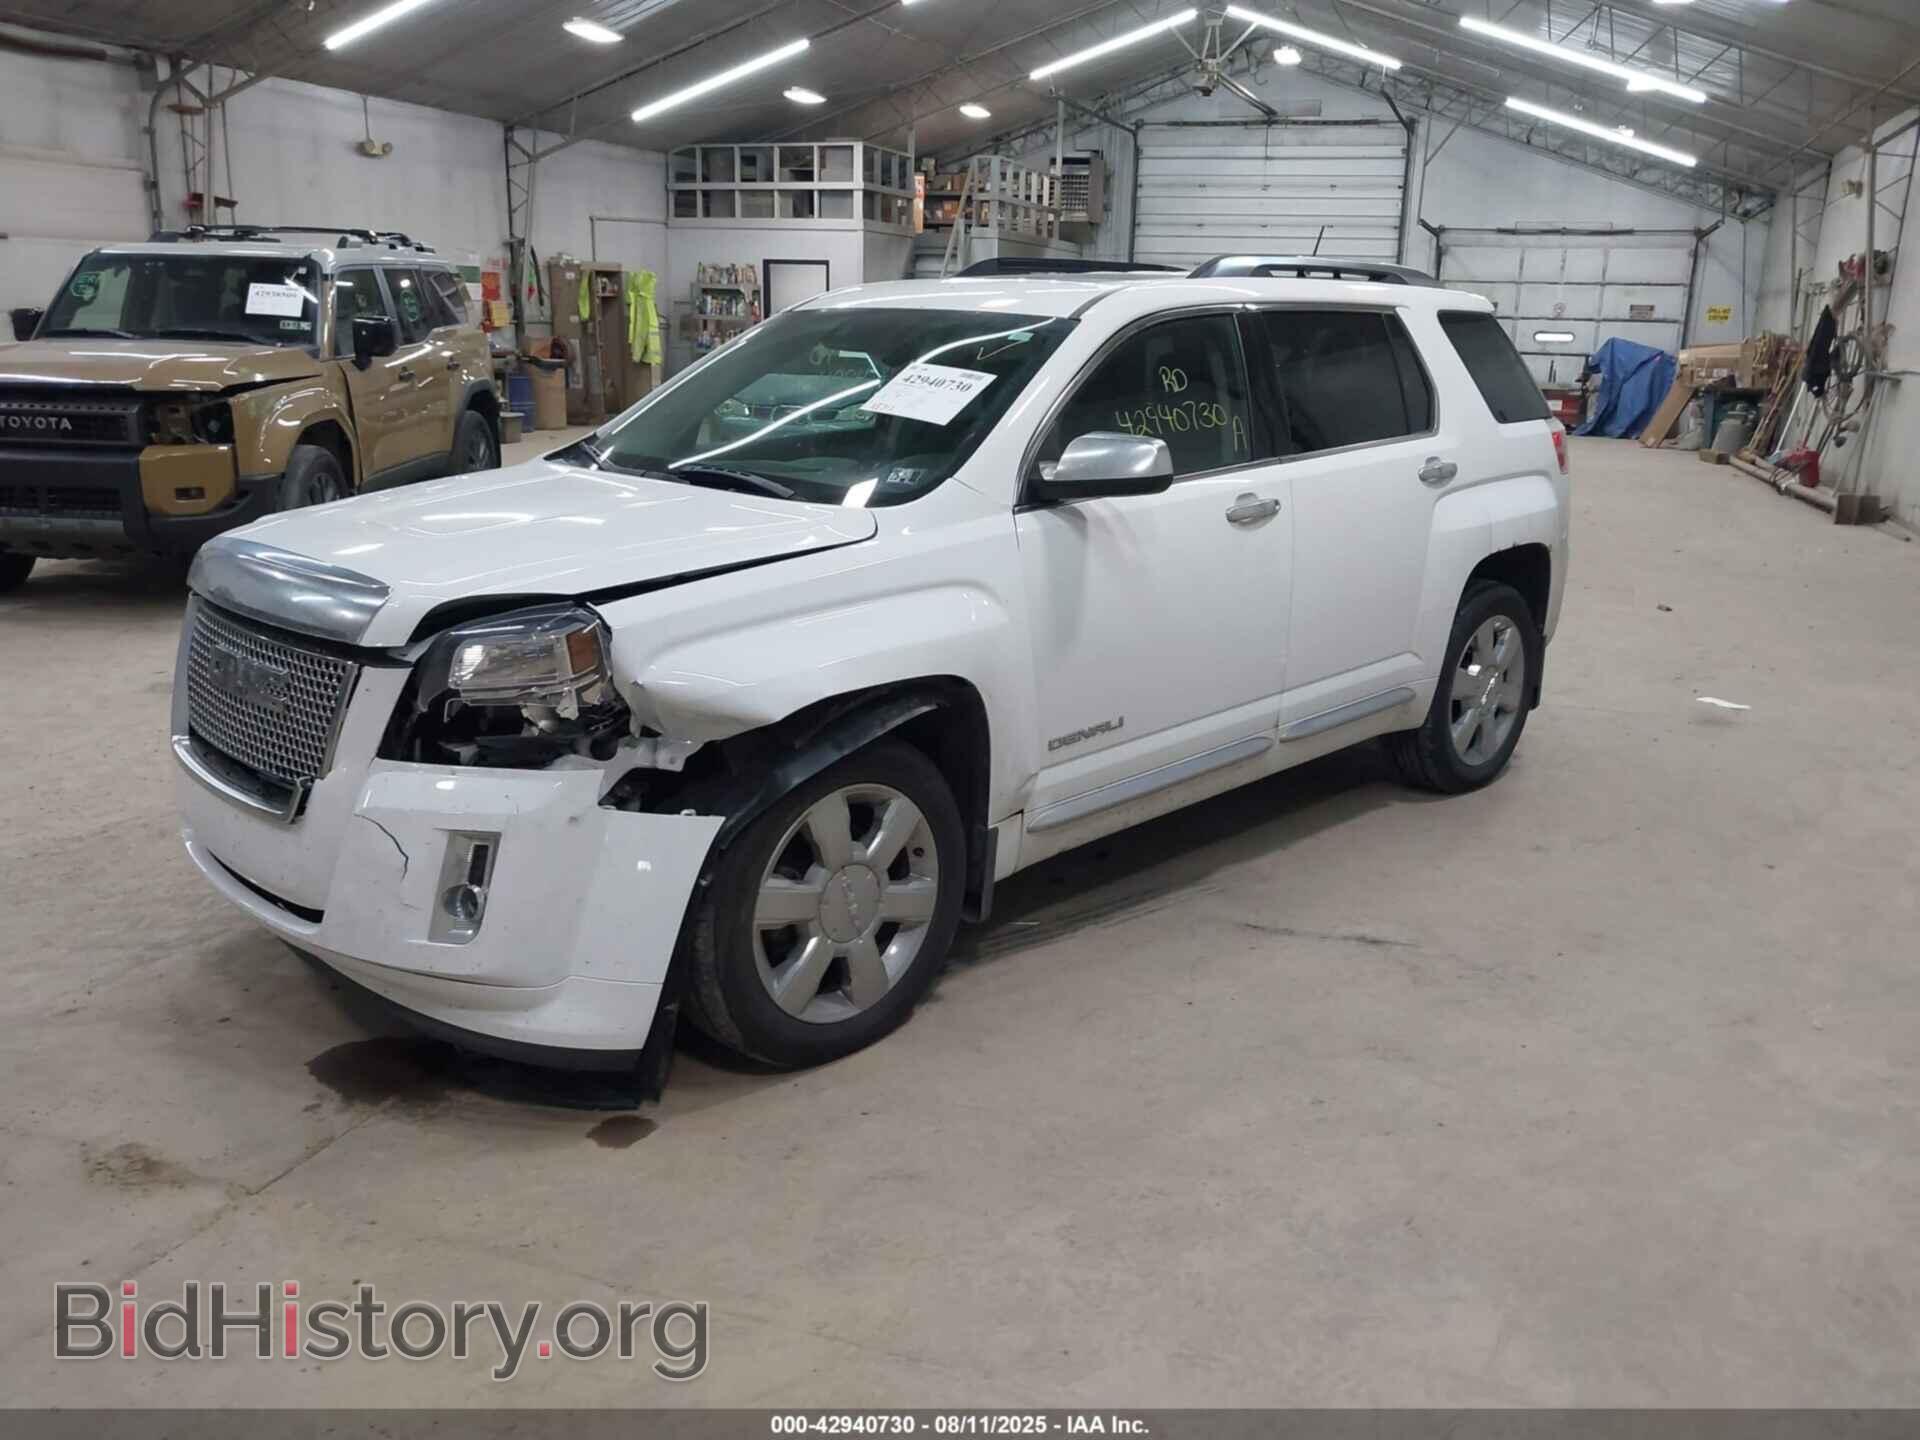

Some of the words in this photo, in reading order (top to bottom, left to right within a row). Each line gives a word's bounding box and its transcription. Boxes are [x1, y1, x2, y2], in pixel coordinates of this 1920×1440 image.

[903, 374, 973, 393] 42940730
[0, 415, 73, 430] TOYOTA
[1114, 400, 1228, 437] 42940730
[1047, 715, 1124, 752] DENALI
